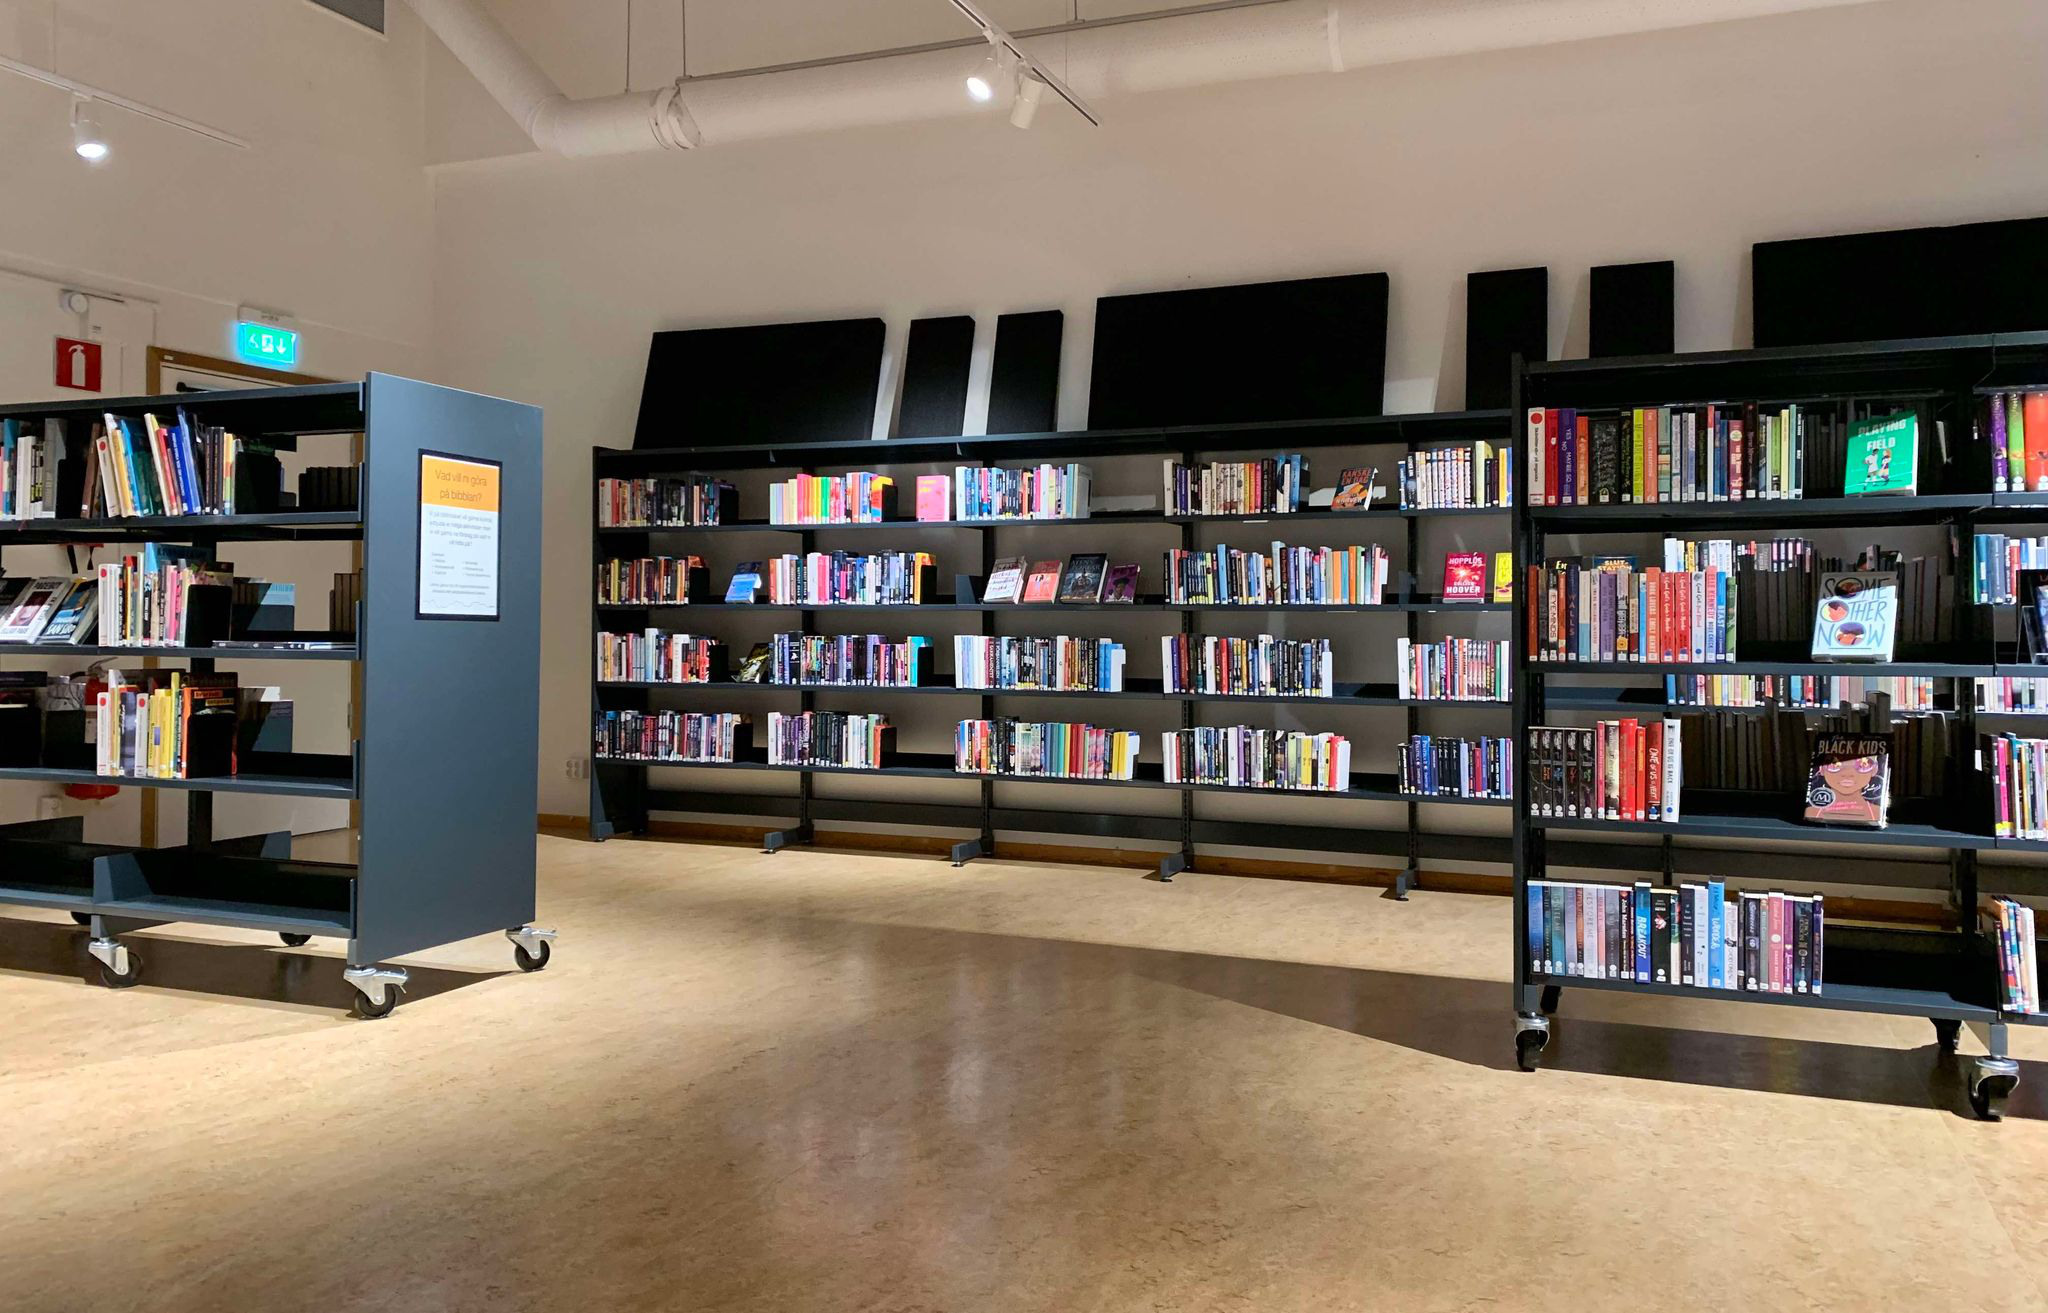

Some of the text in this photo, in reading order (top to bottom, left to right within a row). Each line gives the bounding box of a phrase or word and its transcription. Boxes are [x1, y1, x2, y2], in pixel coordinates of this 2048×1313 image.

[1858, 419, 1906, 438] PLAYING
[1866, 437, 1896, 452] FIELD
[1561, 441, 1567, 451] NO
[1566, 474, 1572, 484] SO
[435, 470, 451, 481] Vad
[471, 476, 487, 488] göra
[440, 488, 450, 500] på
[1446, 586, 1481, 594] HOOVER
[1708, 574, 1716, 588] ELLE
[1822, 578, 1891, 600] SOME
[1708, 590, 1716, 620] KENNEDY
[1820, 600, 1887, 622] OTHER
[1717, 605, 1725, 628] BEAST
[1816, 622, 1886, 648] NOW
[1649, 748, 1660, 764] ONE
[1818, 740, 1887, 754] BLACK KIDS
[1650, 771, 1658, 780] US
[1650, 785, 1658, 799] NEXT
[1636, 916, 1646, 959] BREAKOUT
